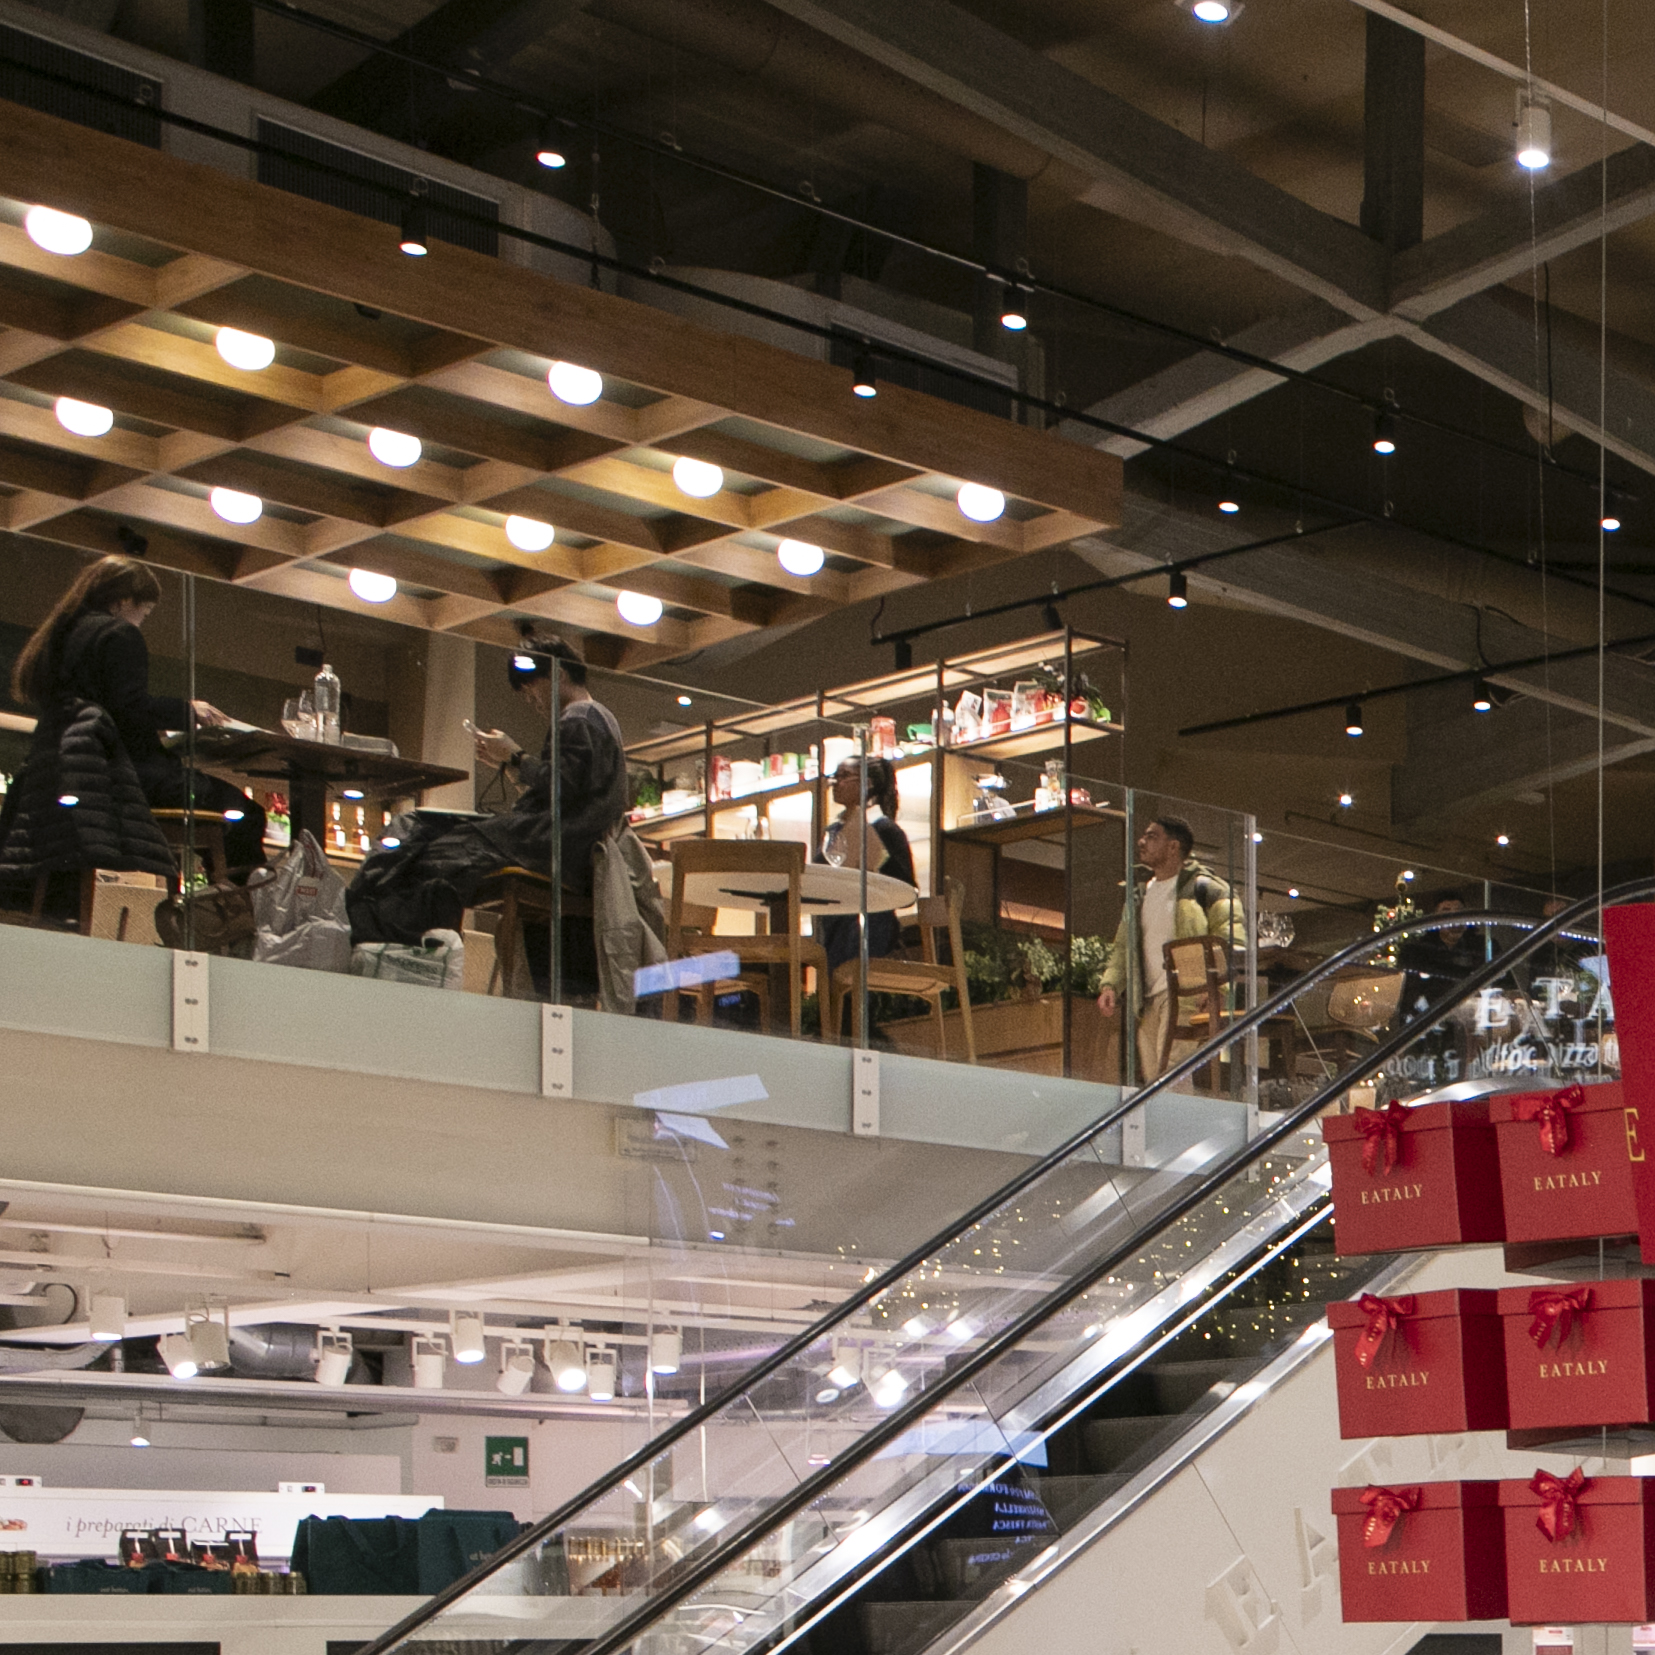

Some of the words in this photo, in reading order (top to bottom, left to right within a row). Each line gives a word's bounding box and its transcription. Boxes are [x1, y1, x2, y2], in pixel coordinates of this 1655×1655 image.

[1533, 1171, 1602, 1191] EATALY
[1361, 1184, 1423, 1205] EATALY
[1539, 1360, 1608, 1378] EATALY
[1366, 1371, 1430, 1390] EATALY
[66, 1517, 72, 1531] i
[181, 1516, 263, 1533] CARNE
[1368, 1560, 1431, 1575] EATALY
[1539, 1558, 1608, 1573] EATALY
